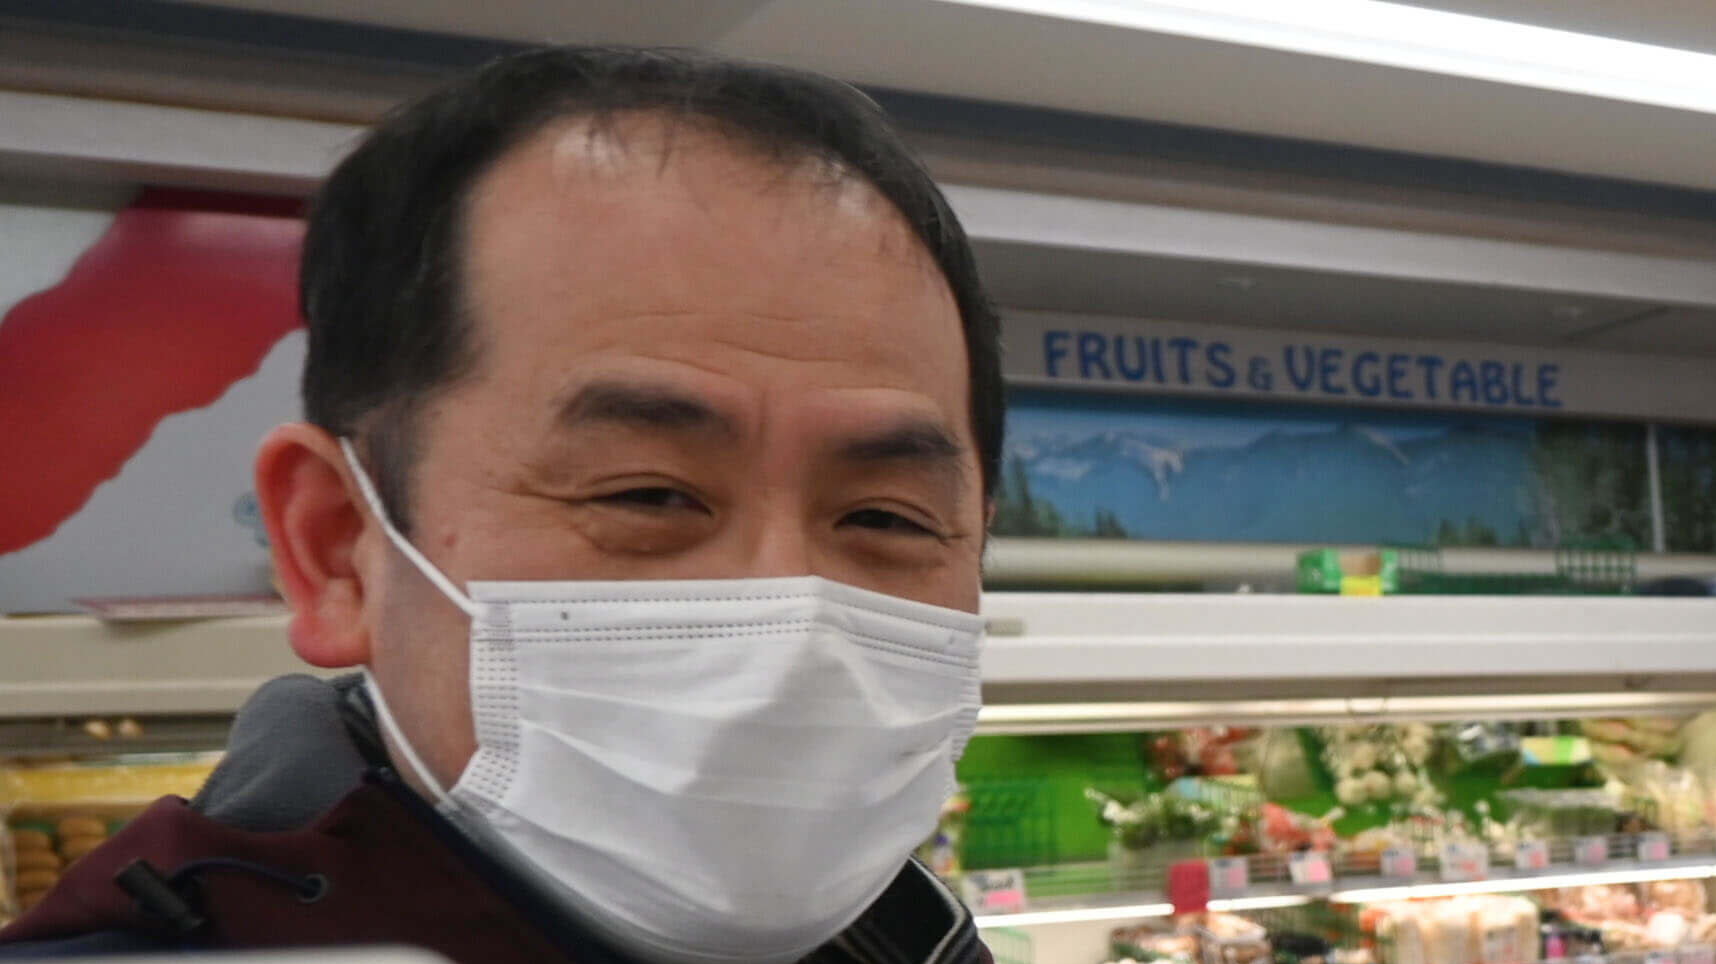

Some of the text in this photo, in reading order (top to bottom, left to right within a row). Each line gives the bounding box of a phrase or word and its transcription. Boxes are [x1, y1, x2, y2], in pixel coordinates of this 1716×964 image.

[1043, 331, 1561, 407] FRUITS & VEGETABLE
